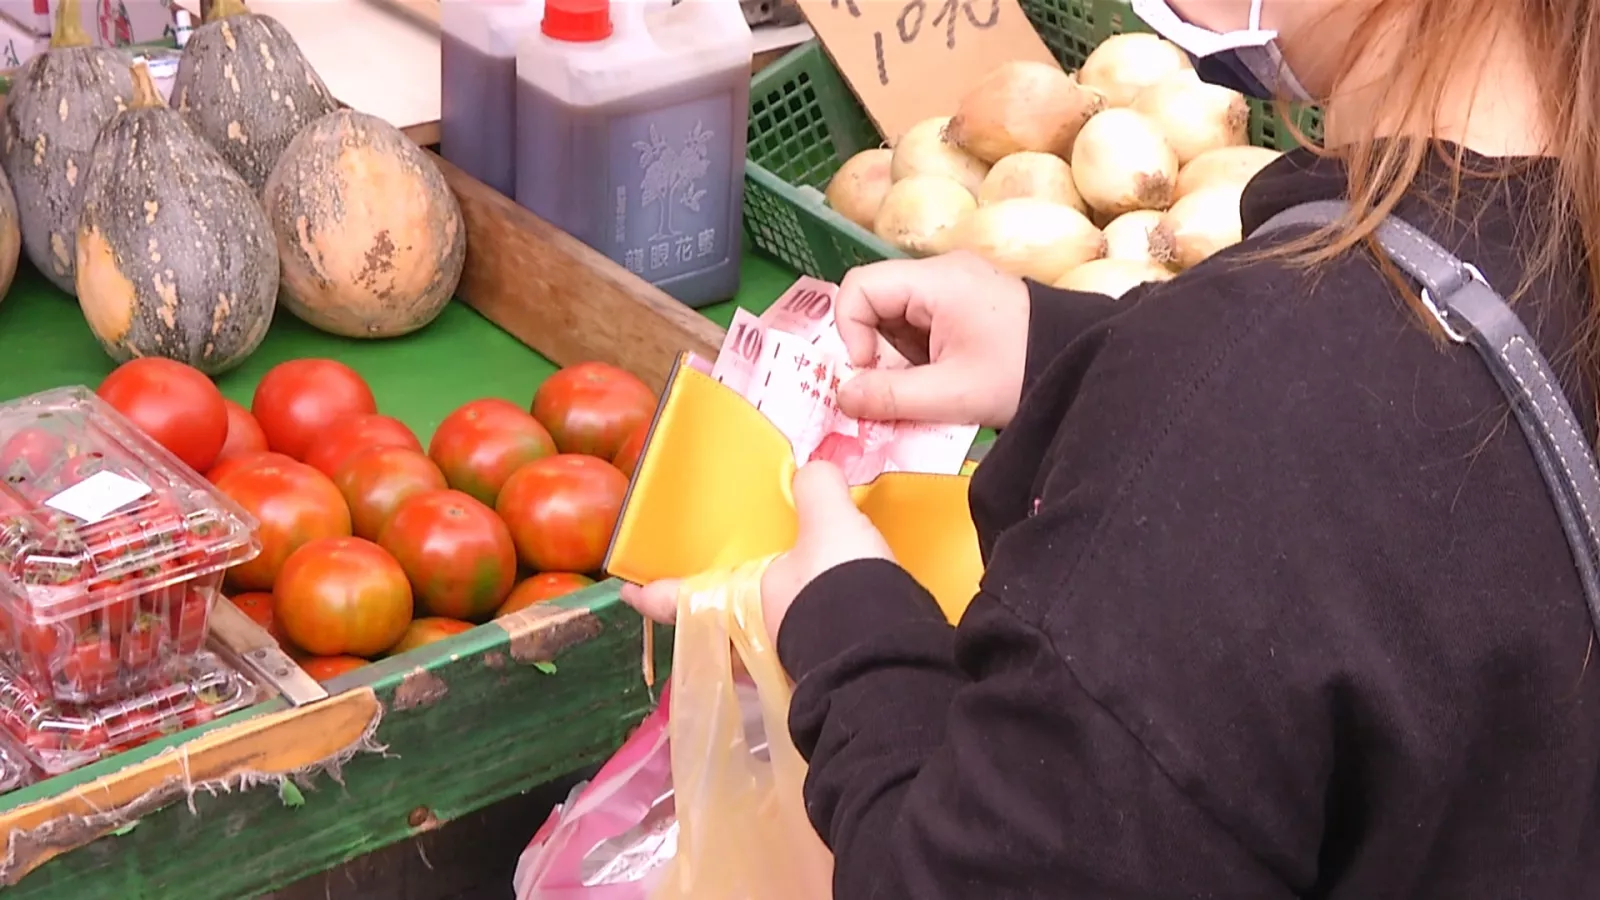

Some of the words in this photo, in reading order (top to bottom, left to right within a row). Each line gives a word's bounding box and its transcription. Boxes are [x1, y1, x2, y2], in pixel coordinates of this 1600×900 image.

[624, 227, 716, 274] 龍眼花蜜
[782, 288, 832, 320] 100
